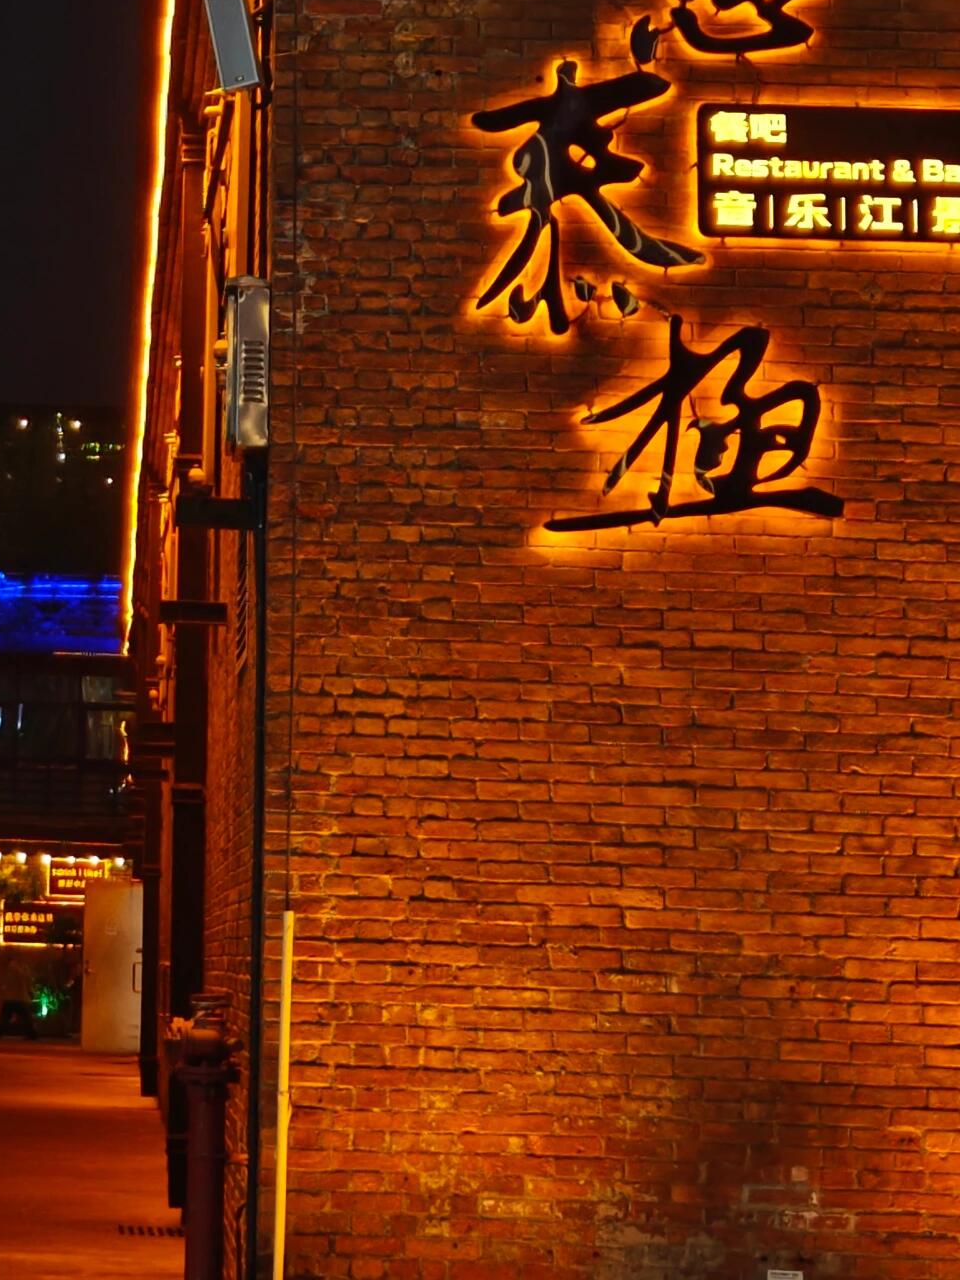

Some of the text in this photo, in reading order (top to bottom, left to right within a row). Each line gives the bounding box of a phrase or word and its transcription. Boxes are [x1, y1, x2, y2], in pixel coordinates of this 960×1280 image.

[710, 111, 787, 144] 餐吧
[712, 153, 885, 181] Restaurant
[892, 159, 916, 183] &
